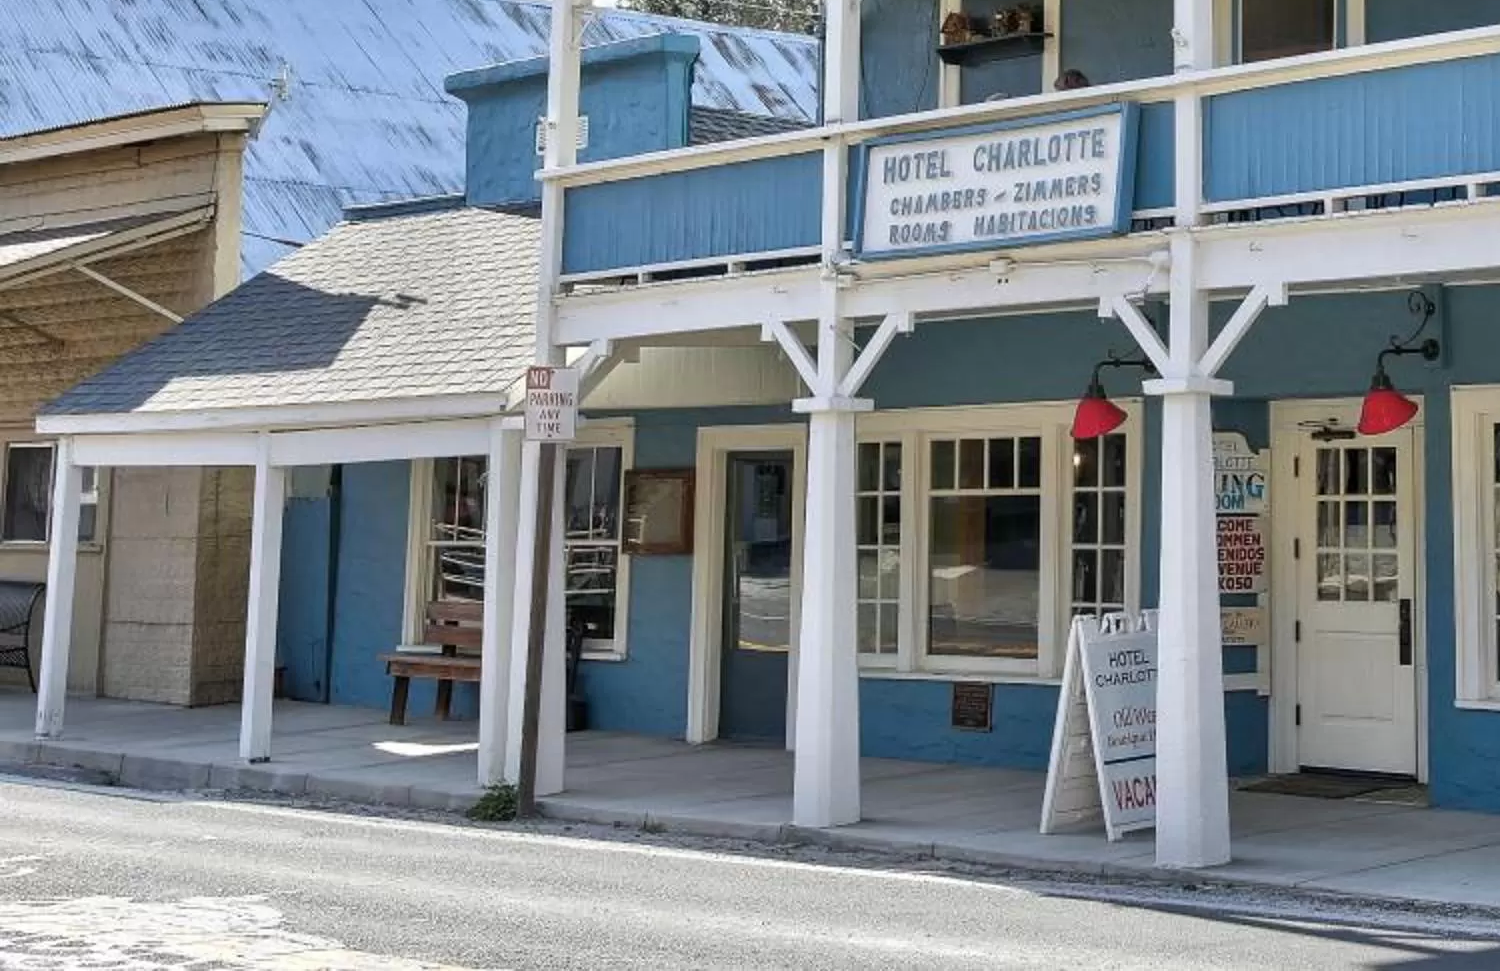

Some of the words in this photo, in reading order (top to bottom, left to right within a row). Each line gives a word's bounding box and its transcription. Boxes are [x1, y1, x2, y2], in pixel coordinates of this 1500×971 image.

[883, 149, 952, 185] HOTEL
[973, 128, 1105, 172] CHARLOTTE
[889, 188, 987, 216] CHAMBERS
[1013, 172, 1102, 202] ZIMMERS
[889, 220, 950, 245] ROOMS
[973, 204, 1097, 236] HABITACIONS
[530, 370, 549, 387] NO
[529, 392, 573, 406] PARKING
[539, 409, 561, 420] ANY
[536, 422, 561, 433] TIME
[1217, 519, 1253, 532] COME
[1217, 547, 1265, 562] ENIDOS
[1217, 562, 1262, 576] VENUE
[1217, 576, 1253, 590] KOSO
[1108, 649, 1150, 668] HOTEL
[1095, 668, 1157, 688] CHARLOT
[1111, 774, 1156, 812] VACA
